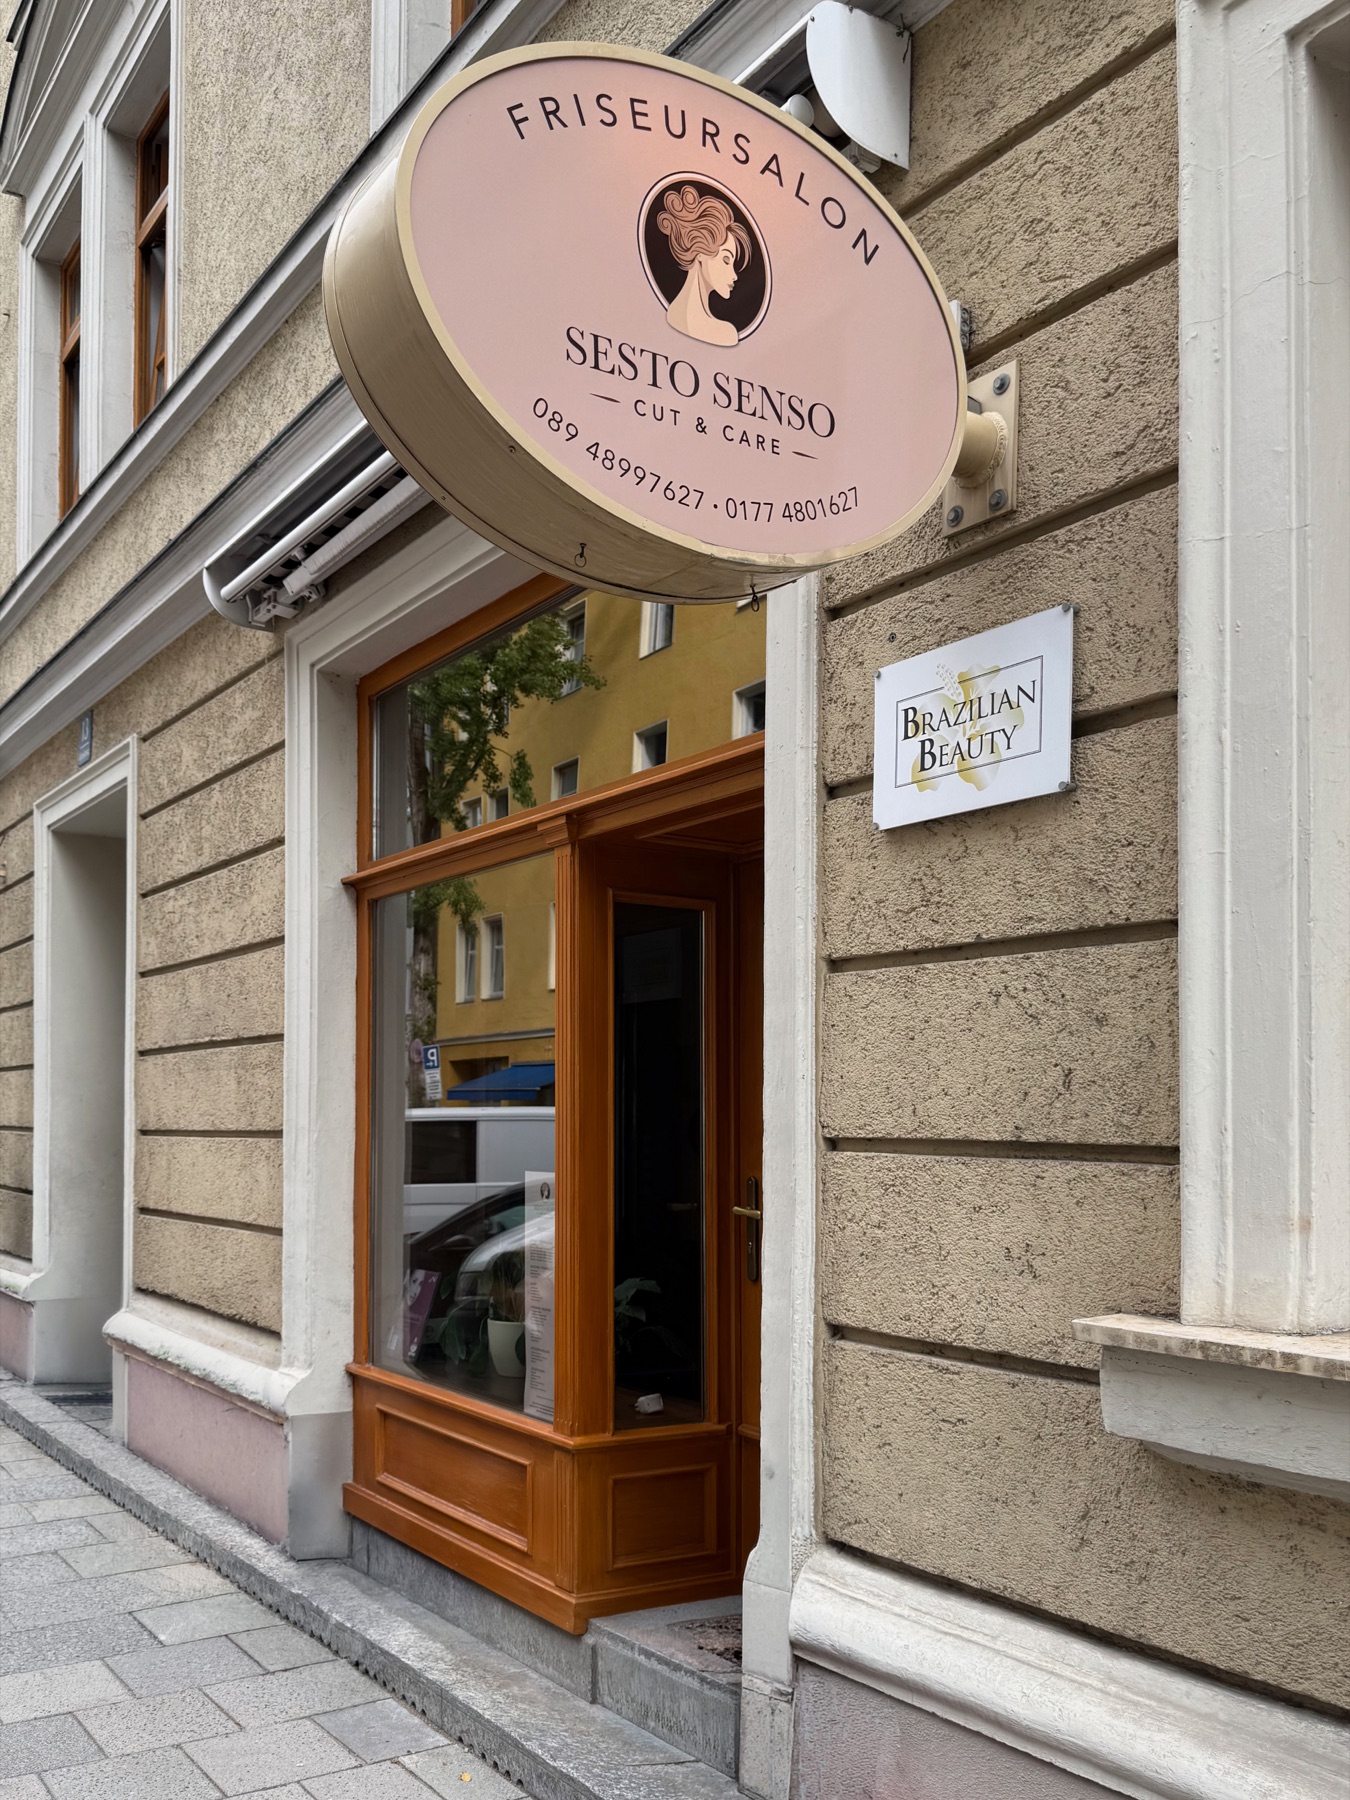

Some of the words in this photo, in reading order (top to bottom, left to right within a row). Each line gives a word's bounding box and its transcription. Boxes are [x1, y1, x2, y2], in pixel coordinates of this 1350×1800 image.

[506, 93, 880, 266] FRISEURSALON
[566, 326, 701, 398] SESTO
[712, 371, 836, 438] SENSO
[532, 397, 579, 442] 089
[585, 441, 705, 510] 48997627
[725, 497, 774, 523] 0177
[781, 486, 860, 523] 4801627
[634, 399, 681, 427] CUT
[695, 416, 708, 435] &
[722, 424, 782, 457] CARE
[901, 680, 1037, 741] BRAZILIAN
[918, 725, 1018, 773] BEAUTY
